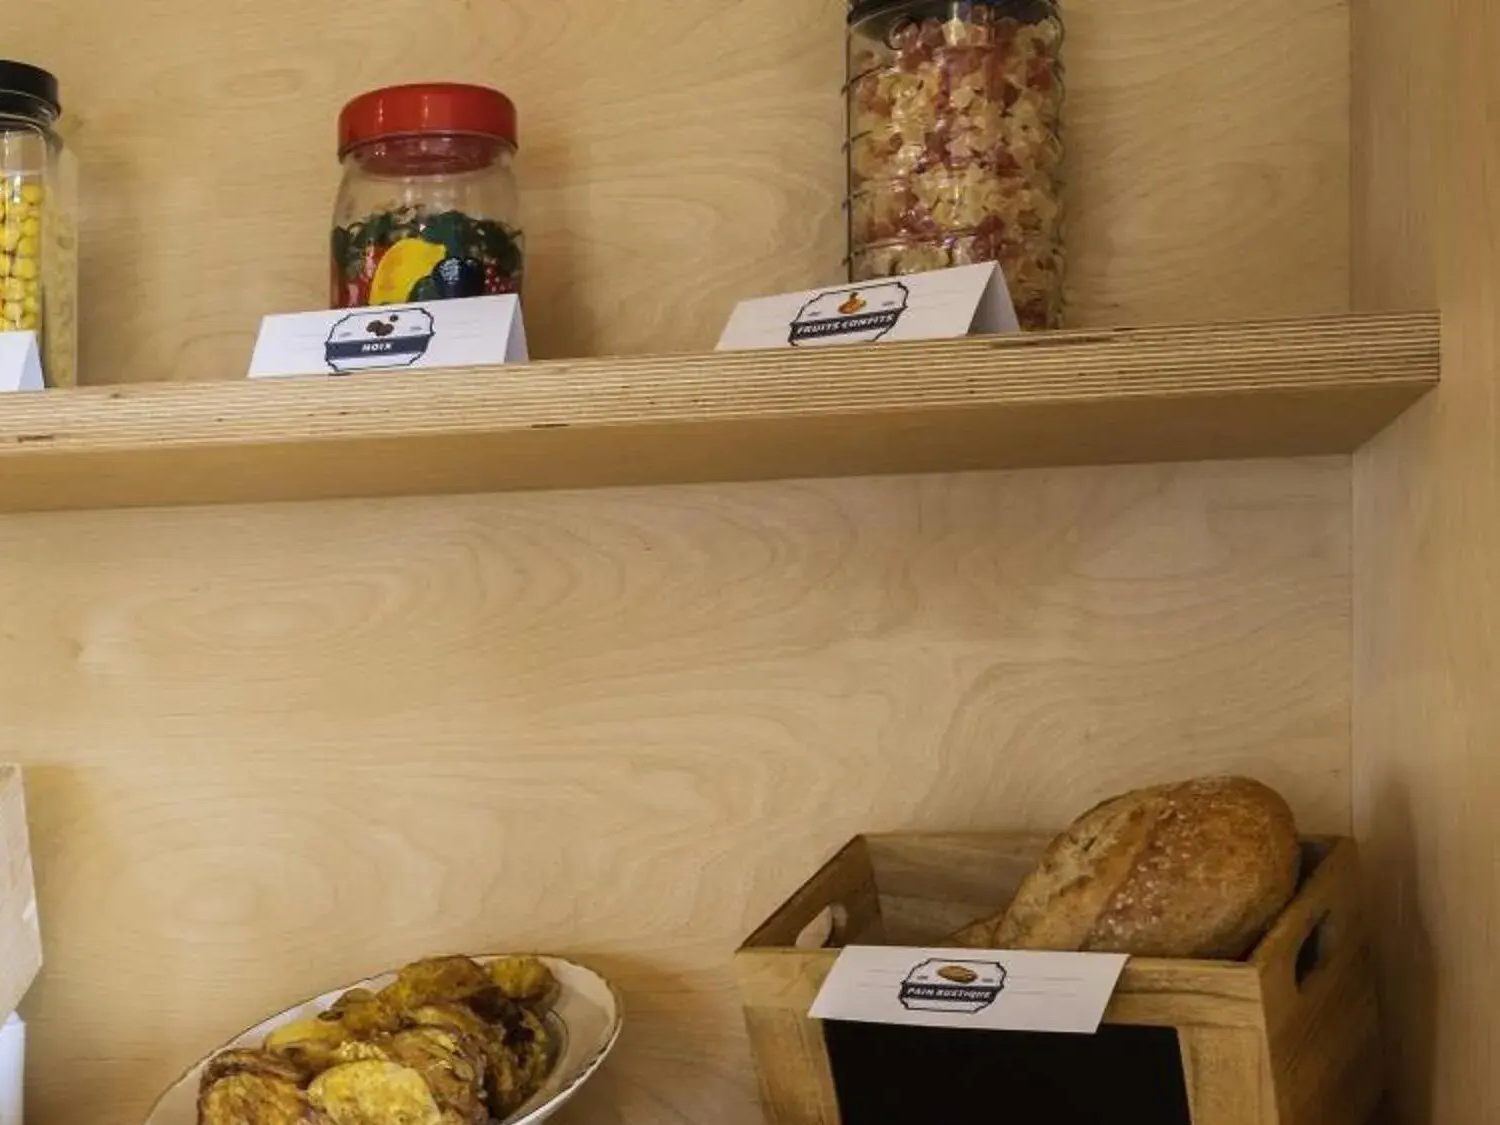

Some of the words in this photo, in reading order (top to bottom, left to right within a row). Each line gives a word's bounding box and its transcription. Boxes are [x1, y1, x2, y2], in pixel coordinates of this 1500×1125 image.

[797, 321, 841, 334] FRUITS
[841, 314, 893, 329] CONFITS
[361, 342, 393, 352] NOIX
[907, 986, 934, 997] PAIN
[935, 988, 992, 999] RUSTIQUE
